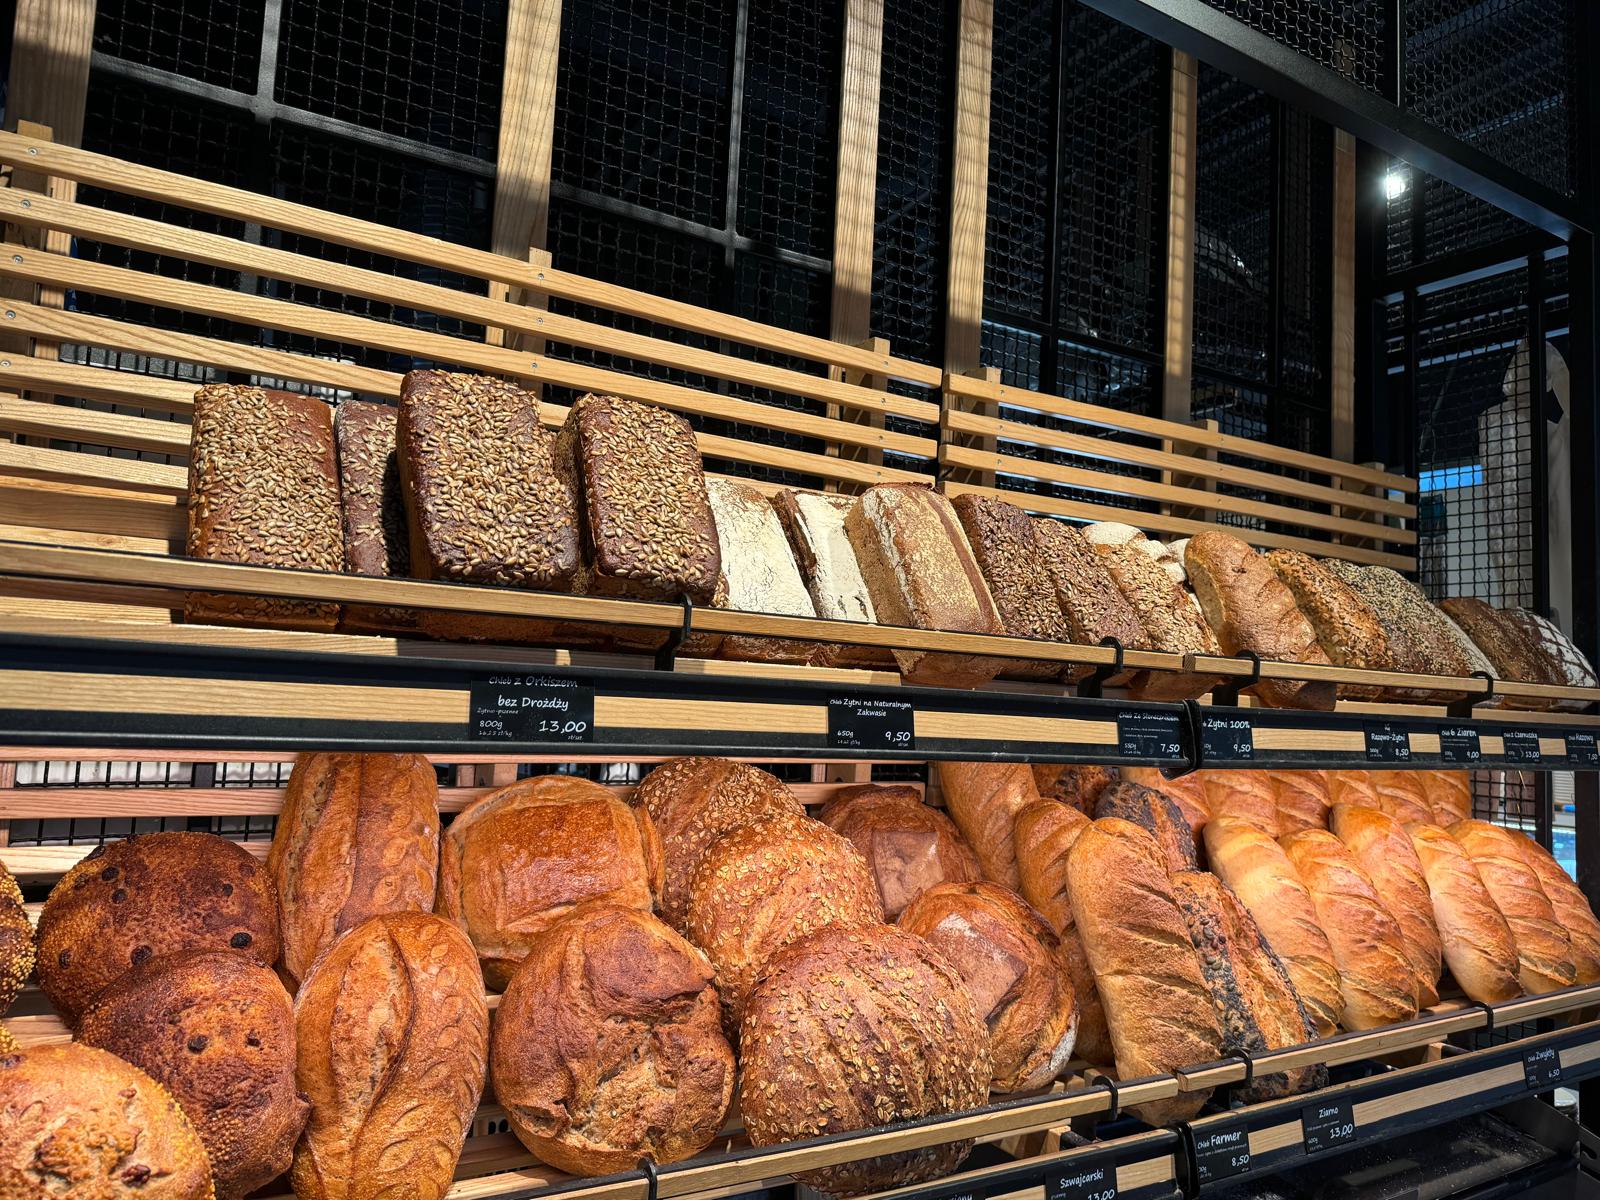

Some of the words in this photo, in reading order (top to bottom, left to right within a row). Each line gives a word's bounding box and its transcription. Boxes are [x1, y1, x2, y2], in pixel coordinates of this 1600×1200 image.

[525, 676, 578, 688] Orkiszem
[497, 694, 518, 707] bez
[521, 697, 569, 711] Drożdży
[843, 697, 862, 707] Żytni
[873, 700, 912, 710] Naturalnym
[856, 708, 887, 717] Zakwasie
[479, 720, 503, 730] 800g
[538, 719, 587, 734] 13,00
[1207, 715, 1228, 730] Żytni
[1230, 720, 1250, 728] 100%
[837, 730, 854, 738] 650g
[885, 731, 911, 742] 9,50
[1450, 728, 1456, 736] 6
[1160, 743, 1180, 753] 7,50
[1233, 743, 1251, 753] 9,50
[1395, 748, 1409, 756] 8,50
[1466, 751, 1480, 759] 9,00
[1525, 751, 1540, 759] 13,00
[1318, 1107, 1339, 1118] Ziarno
[1330, 1123, 1354, 1139] 13,00
[1211, 1131, 1242, 1146] Farmer
[1231, 1154, 1250, 1167] 8,50
[1060, 1168, 1104, 1189] Szwajcarski
